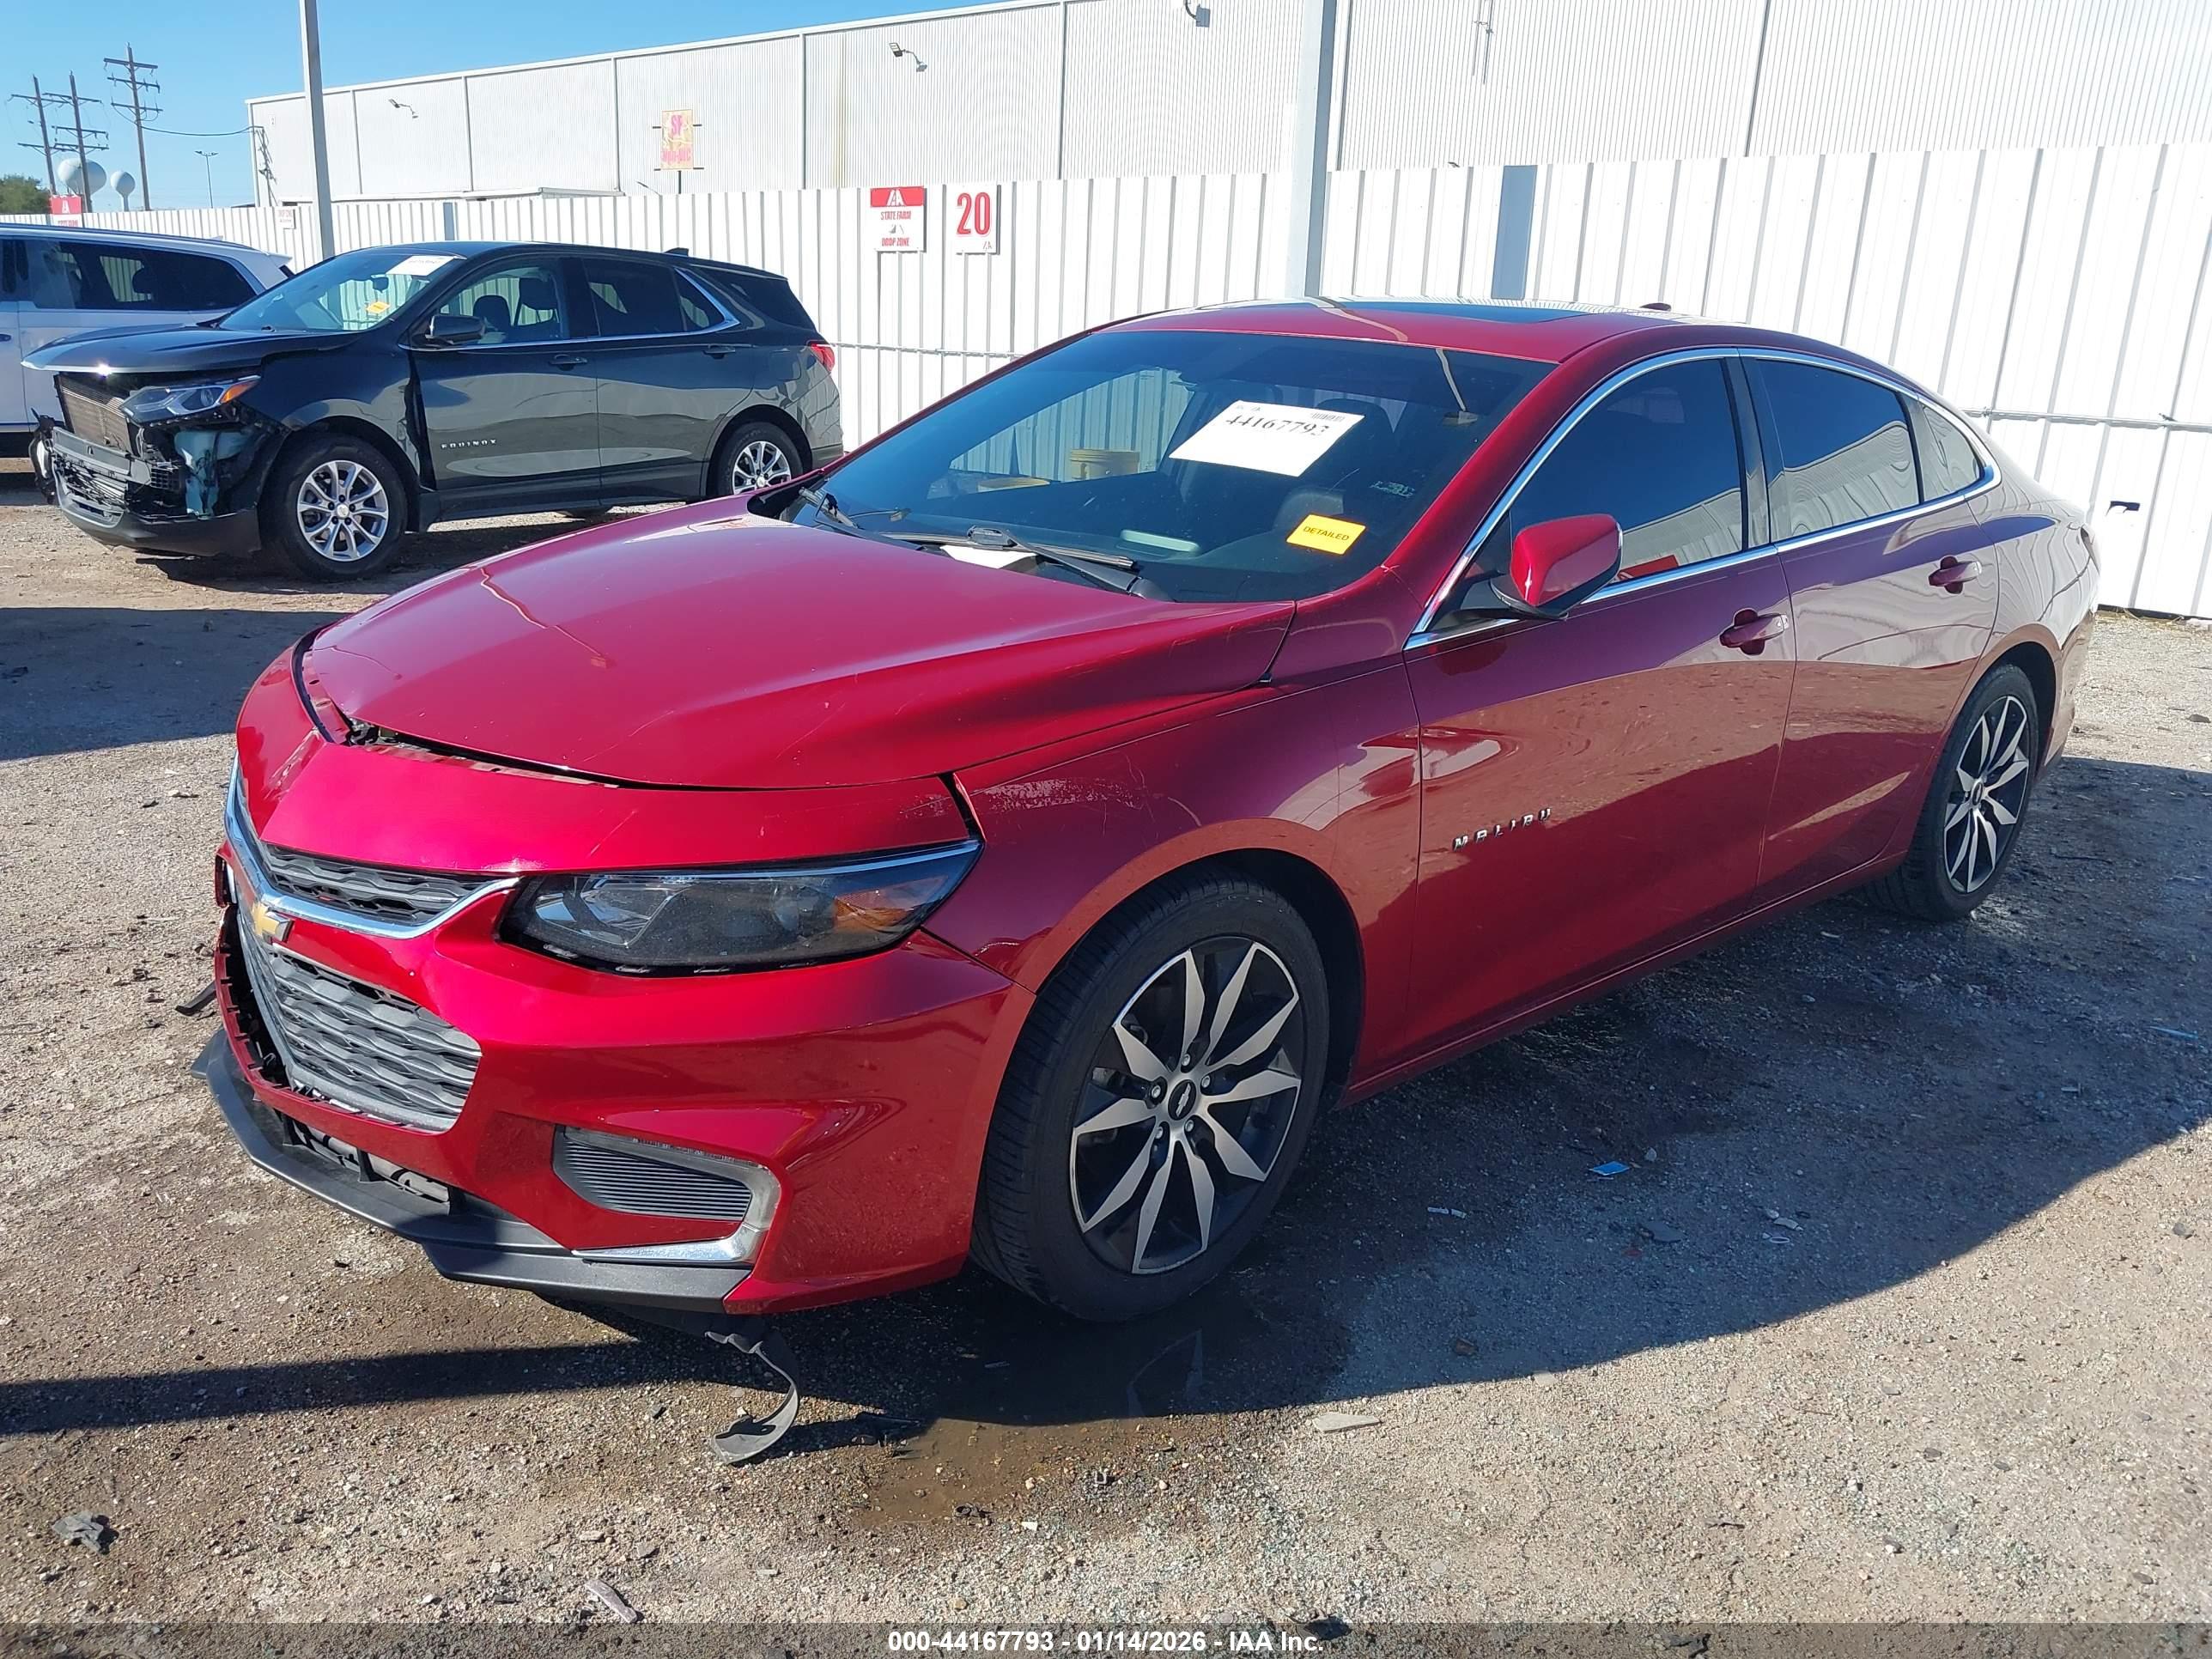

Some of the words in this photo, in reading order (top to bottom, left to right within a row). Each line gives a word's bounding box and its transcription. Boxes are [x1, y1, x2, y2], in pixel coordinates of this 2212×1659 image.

[880, 211, 896, 221] STATE
[956, 191, 991, 235] 20
[896, 237, 909, 246] ZONE
[1225, 414, 1330, 437] 44167793
[441, 439, 496, 449] EQUINOX
[1303, 526, 1350, 542] DETAILED
[1452, 807, 1551, 852] MALIBU
